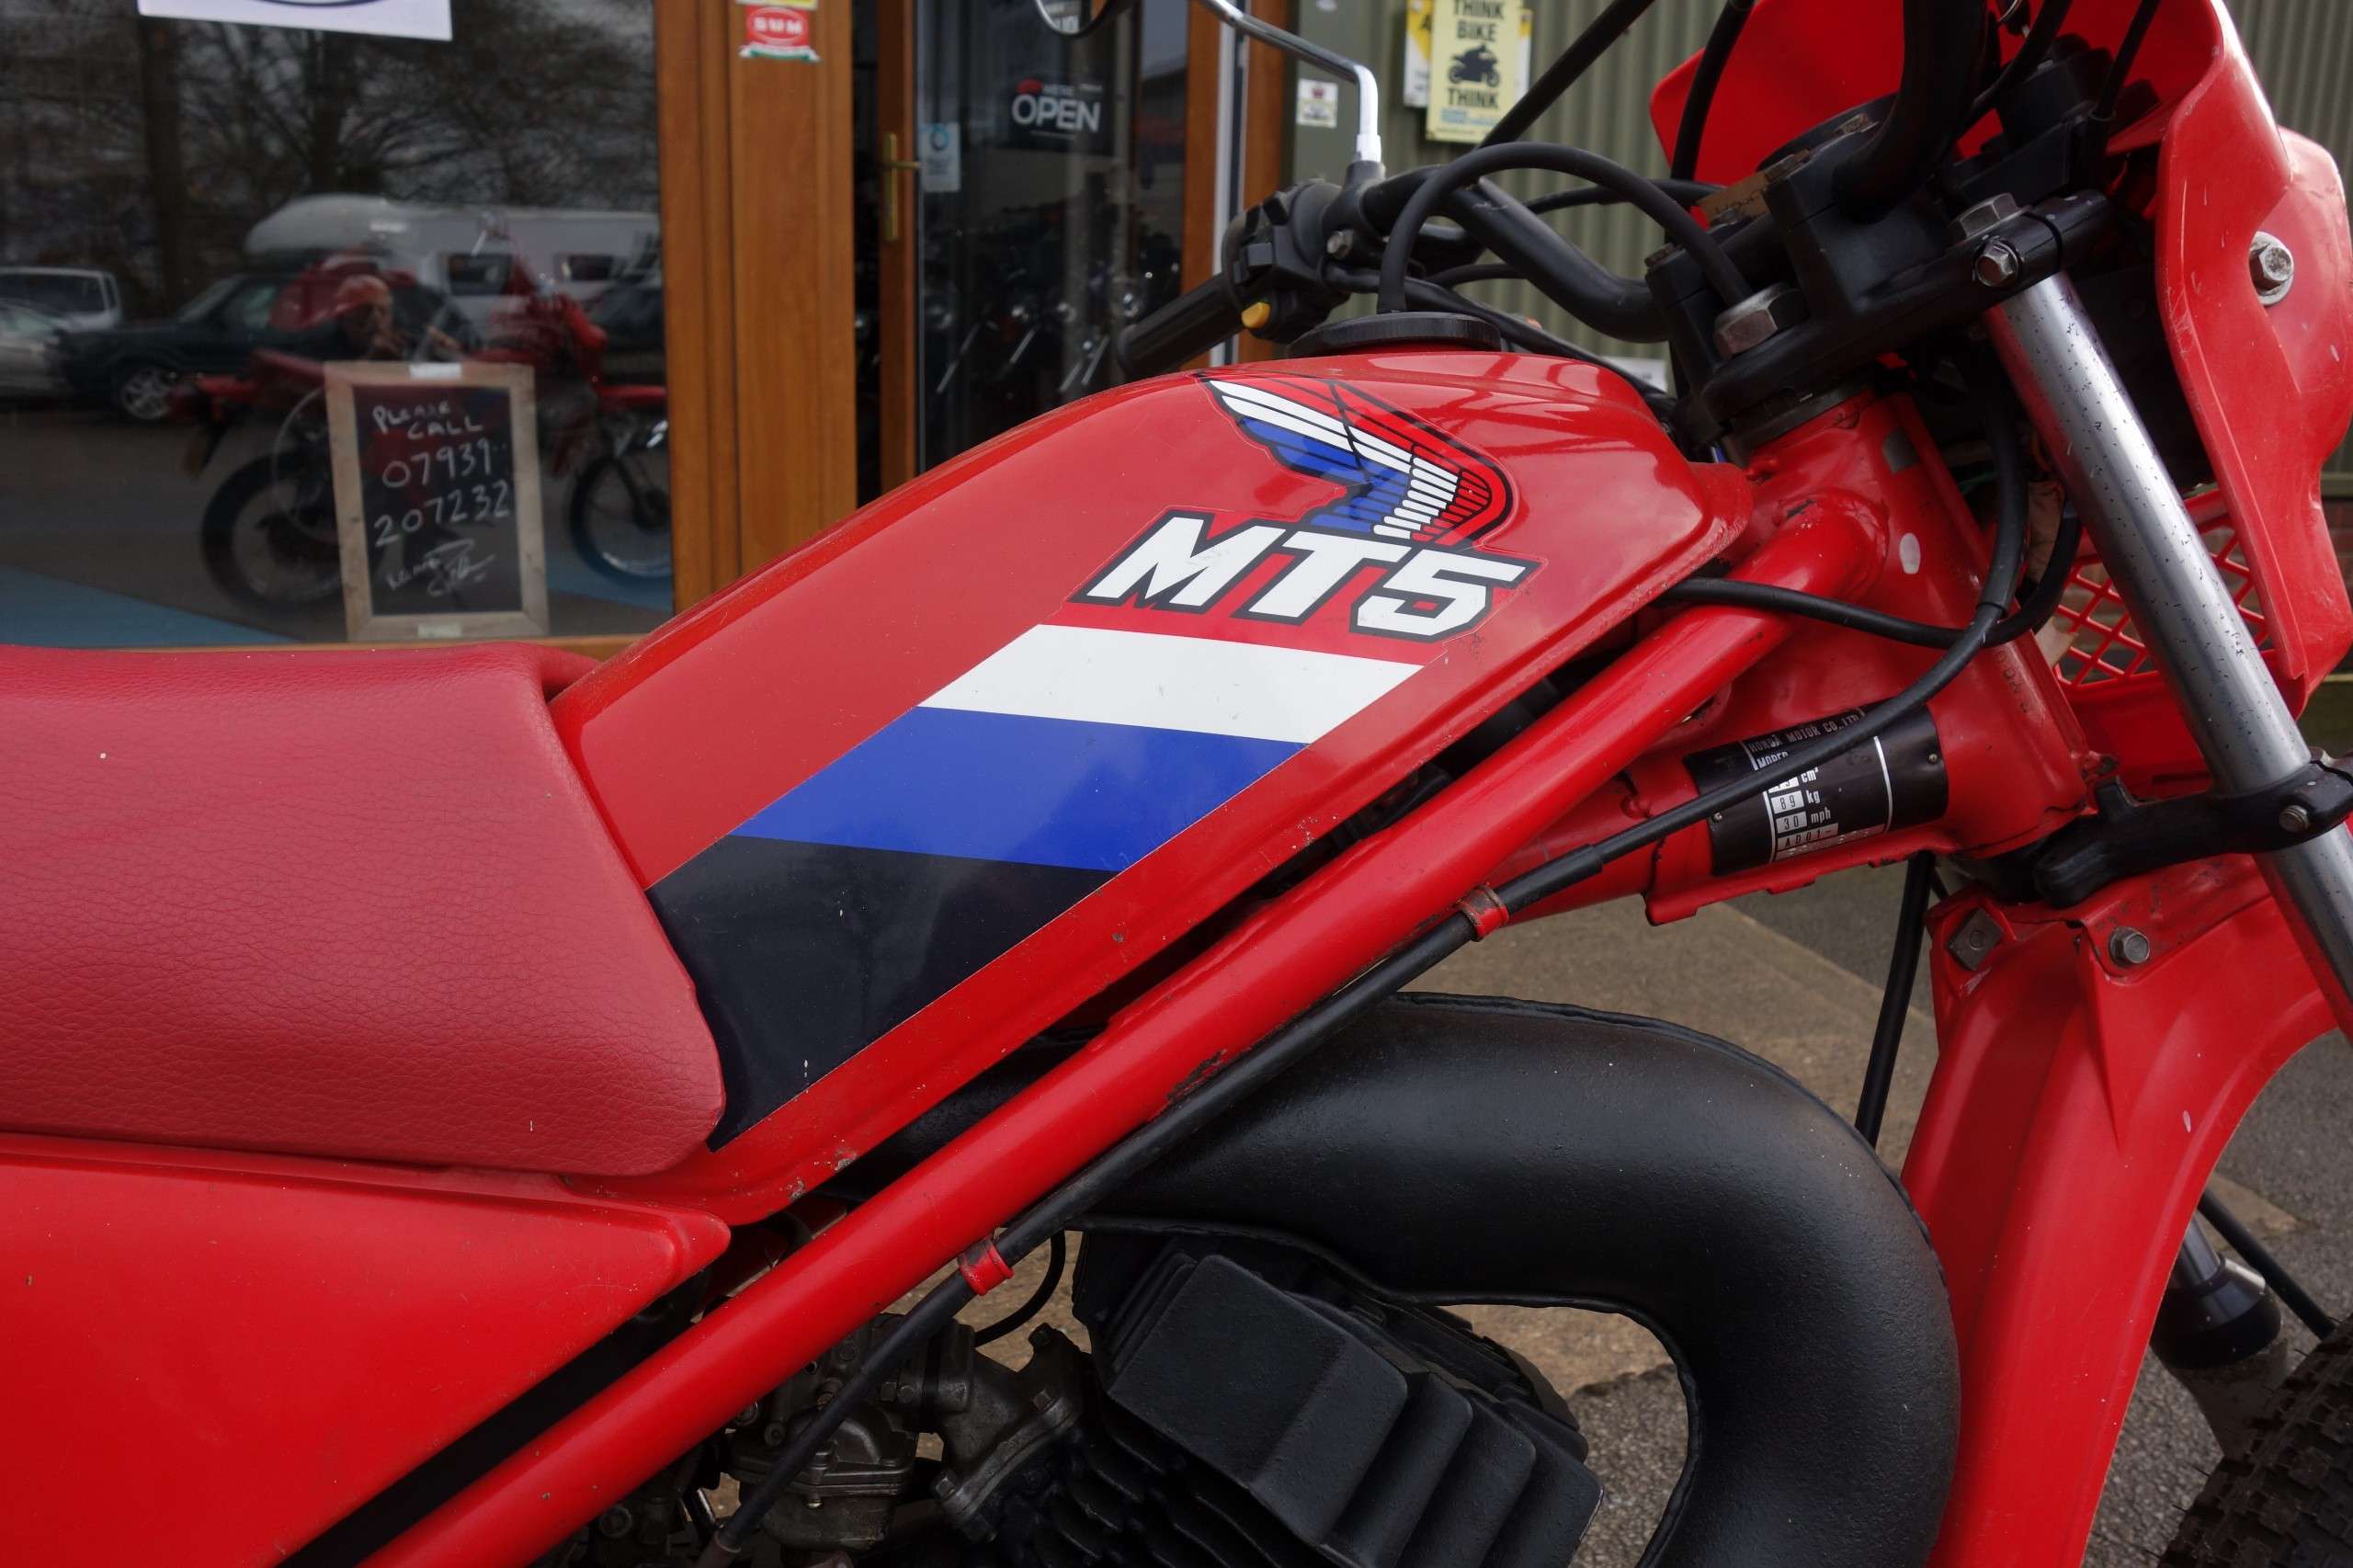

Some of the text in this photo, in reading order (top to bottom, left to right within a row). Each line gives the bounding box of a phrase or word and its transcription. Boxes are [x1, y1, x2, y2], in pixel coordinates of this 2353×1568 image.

[1457, 20, 1496, 41] BIKE
[1448, 88, 1498, 108] THINK
[1012, 95, 1101, 132] OPEN
[408, 416, 483, 438] CALL
[381, 437, 491, 487] 07939
[374, 479, 509, 546] 207232
[1077, 511, 1537, 642] MT5
[1749, 734, 1783, 753] HONDA
[1787, 725, 1821, 743] MOTOR
[1779, 790, 1820, 811] 89 kg
[1784, 806, 1831, 830] 30 mph
